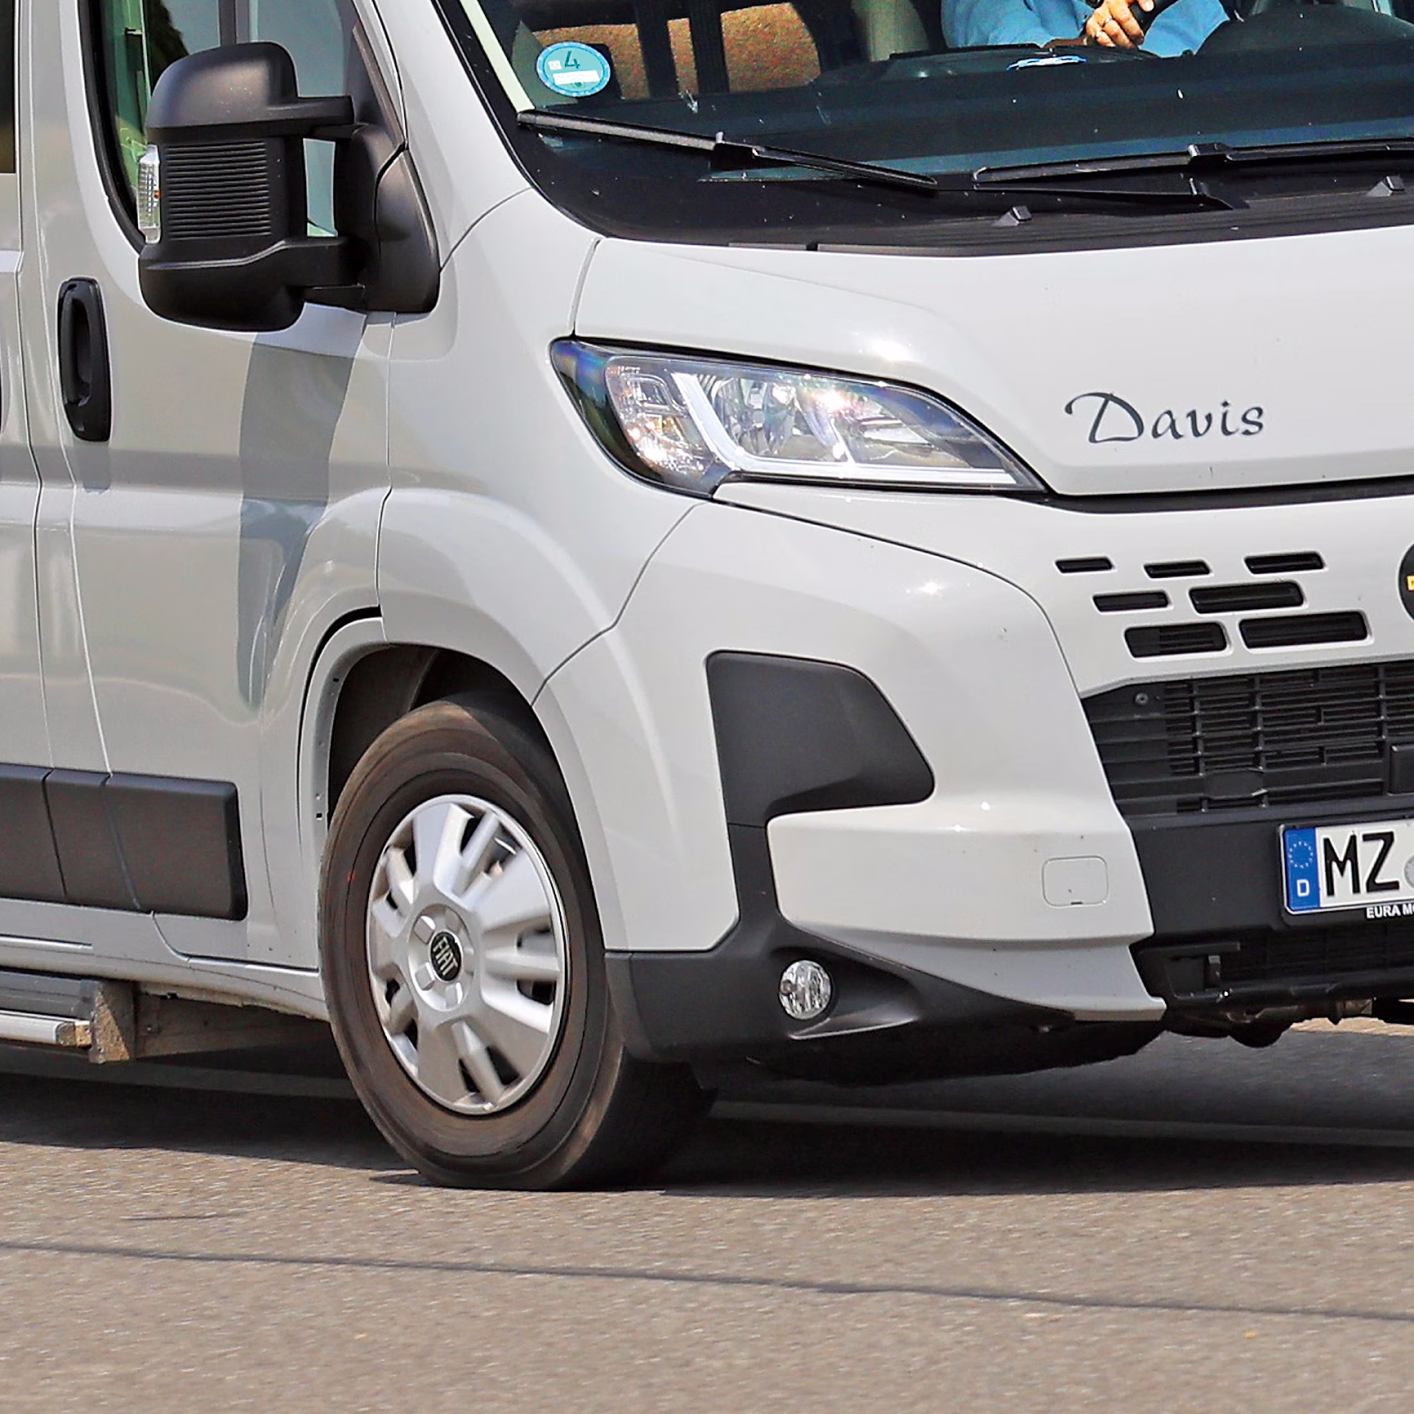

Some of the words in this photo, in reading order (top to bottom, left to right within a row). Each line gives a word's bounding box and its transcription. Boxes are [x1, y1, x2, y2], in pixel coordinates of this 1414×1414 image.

[564, 50, 580, 69] 4
[1064, 391, 1264, 444] Davis
[1323, 831, 1400, 897] MZ
[1297, 879, 1310, 897] D
[1366, 905, 1401, 919] EURA
[432, 936, 459, 976] FIAT
